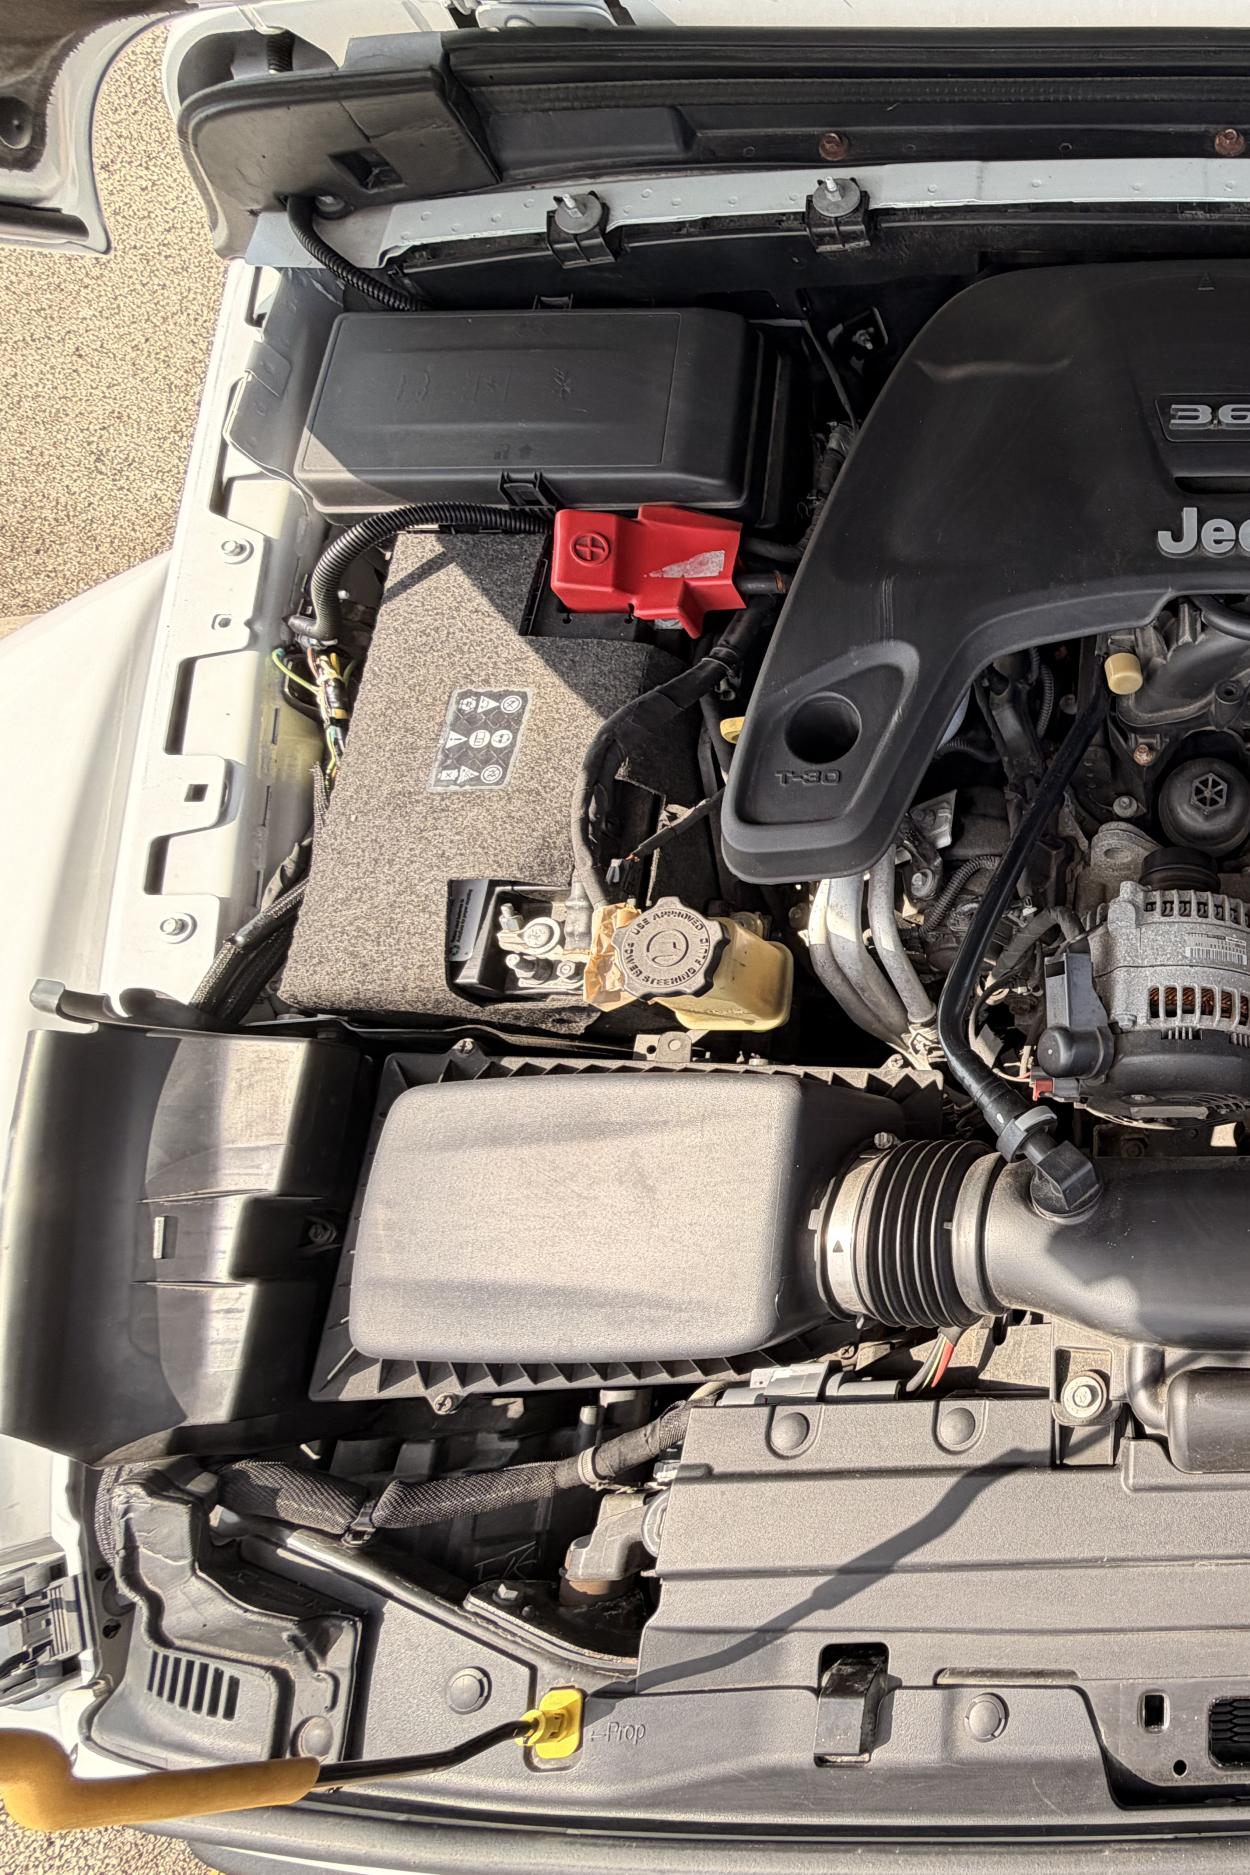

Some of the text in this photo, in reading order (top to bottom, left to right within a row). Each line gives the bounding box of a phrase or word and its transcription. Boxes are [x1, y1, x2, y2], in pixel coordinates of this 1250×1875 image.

[774, 769, 842, 787] T-30
[652, 910, 704, 931] APPROVED
[641, 967, 697, 985] STEERING
[607, 1721, 646, 1745] Prop
